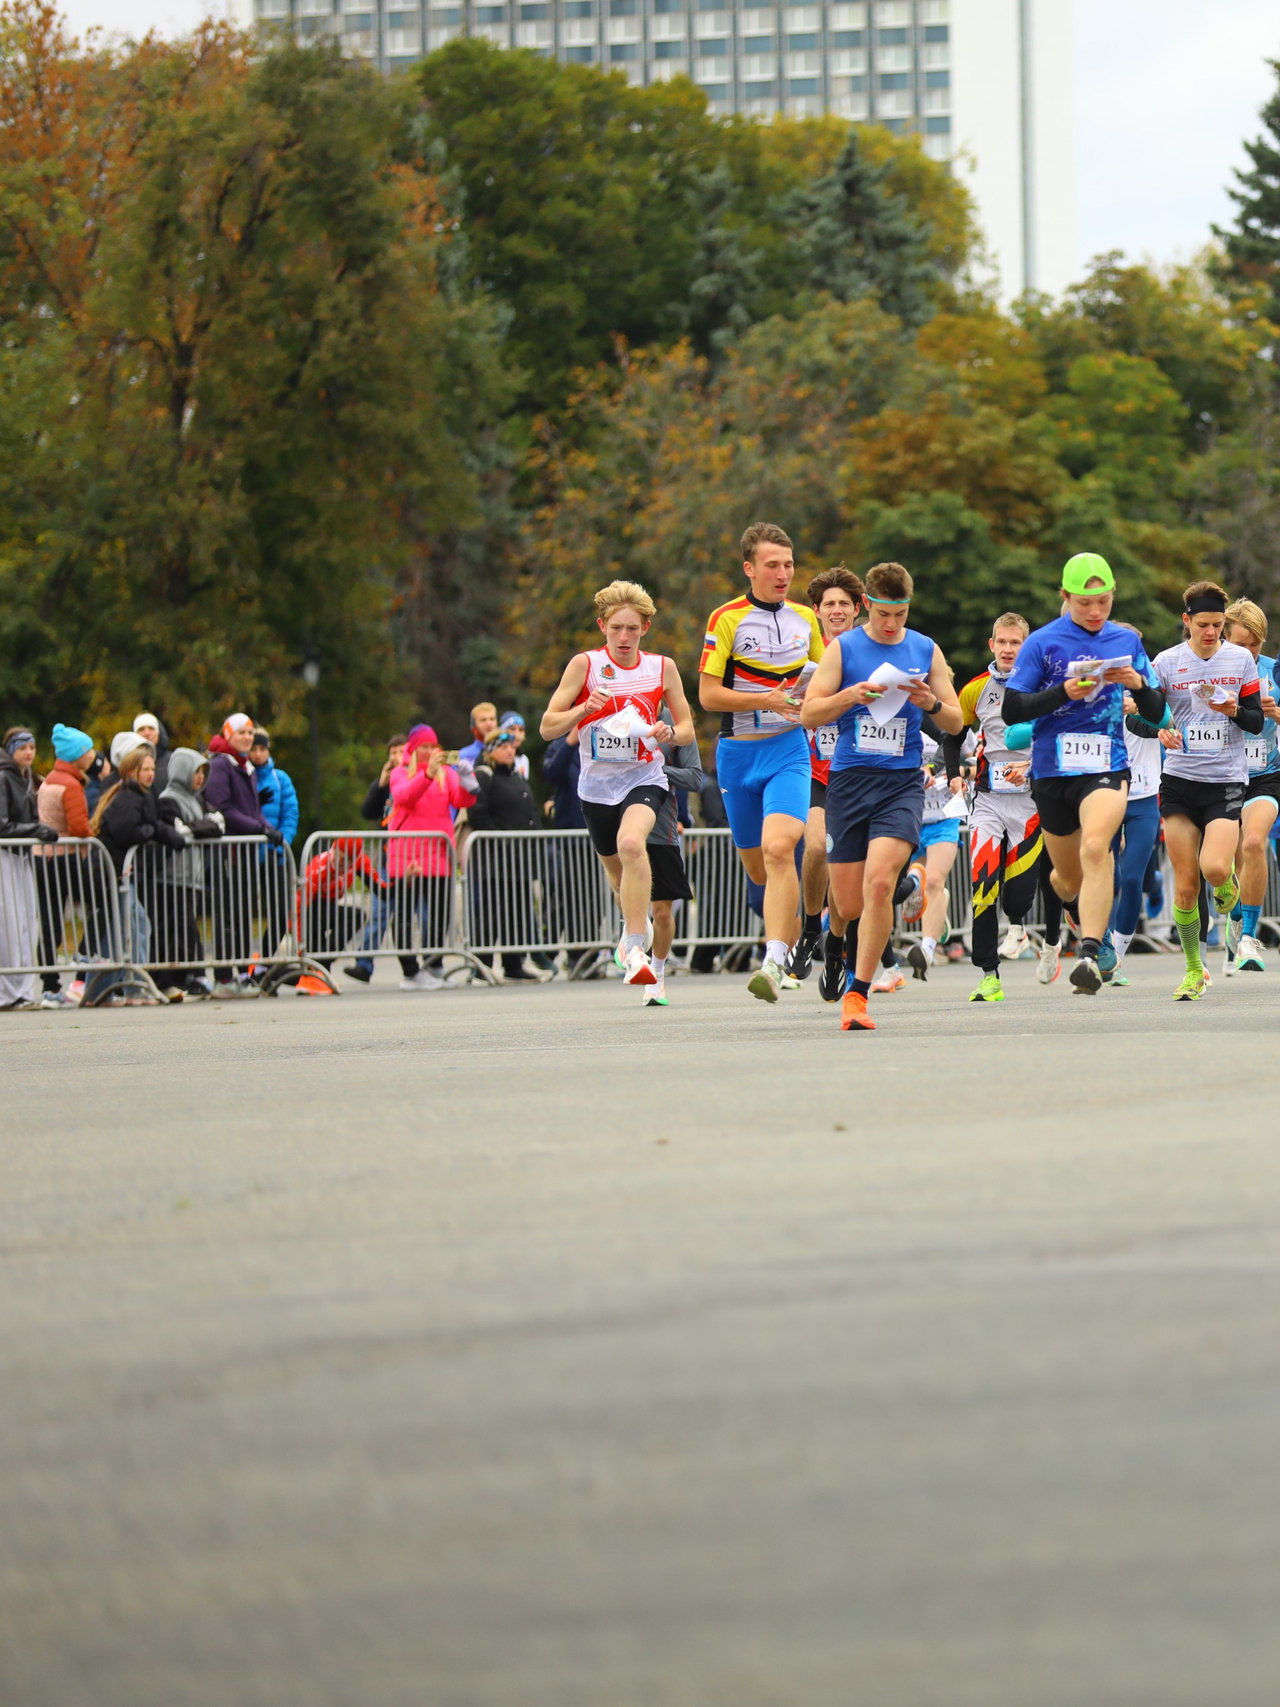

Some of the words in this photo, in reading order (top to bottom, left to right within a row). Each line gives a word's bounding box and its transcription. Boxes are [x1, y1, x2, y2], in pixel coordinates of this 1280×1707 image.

[1210, 676, 1244, 686] WEST
[860, 724, 898, 741] 220.1
[1189, 729, 1221, 741] 216.1
[598, 737, 632, 749] 229.1
[1064, 741, 1102, 756] 219.1
